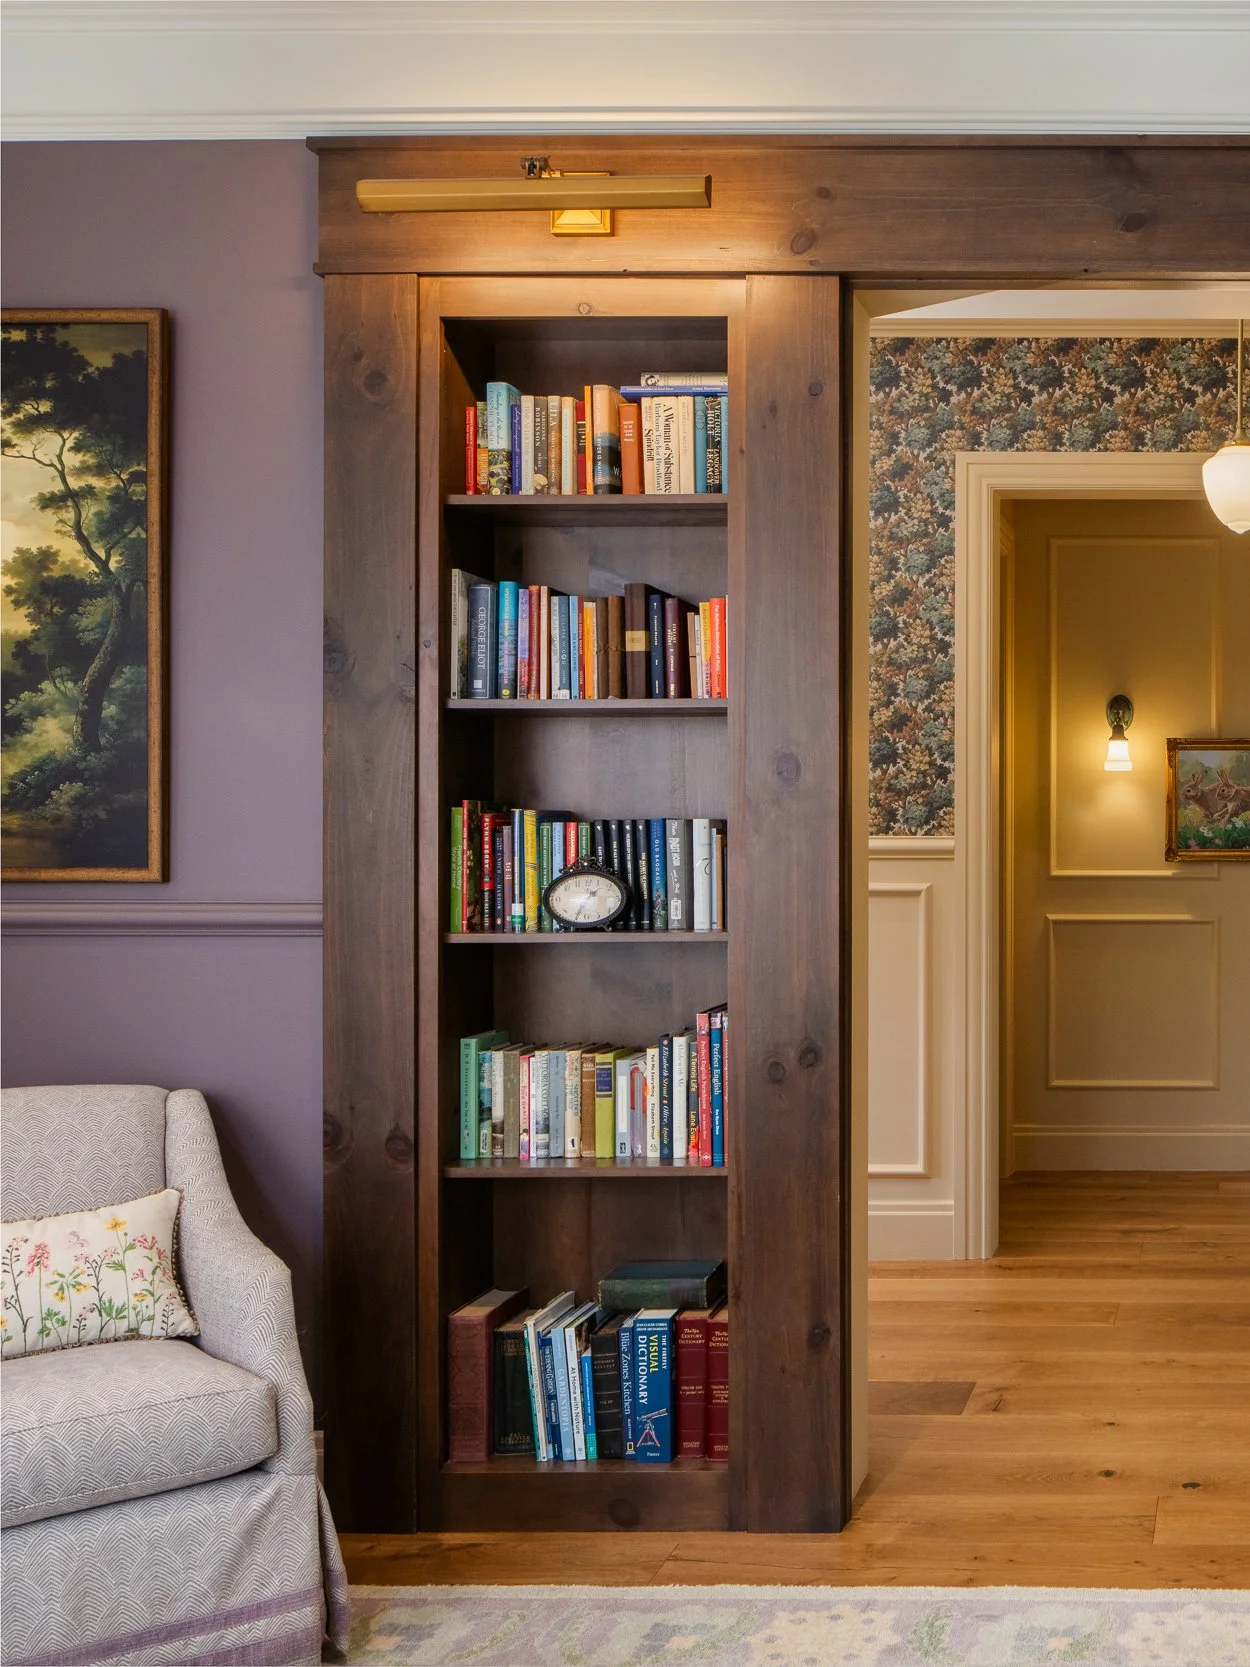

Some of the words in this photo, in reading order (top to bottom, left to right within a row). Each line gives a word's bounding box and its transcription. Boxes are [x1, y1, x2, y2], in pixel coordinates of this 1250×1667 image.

[663, 404, 672, 412] A
[663, 413, 674, 443] Woman
[644, 429, 654, 462] Spindrift
[654, 435, 662, 456] Taylor
[664, 444, 672, 452] of
[664, 453, 674, 494] Substance
[706, 449, 714, 484] LEGACY
[477, 607, 486, 643] GEORGE
[477, 645, 486, 670] ELIOT
[669, 837, 680, 853] FINEST
[672, 853, 680, 866] HOUR
[677, 1078, 683, 1087] Me
[713, 1069, 721, 1095] English
[620, 1332, 630, 1351] Blue
[649, 1334, 659, 1373] VISUAL
[570, 1367, 576, 1375] At
[621, 1353, 631, 1379] Zones
[638, 1335, 648, 1405] DICTIONARY
[557, 1368, 570, 1432] GARDENTOPIA
[623, 1382, 632, 1415] Kitchen
